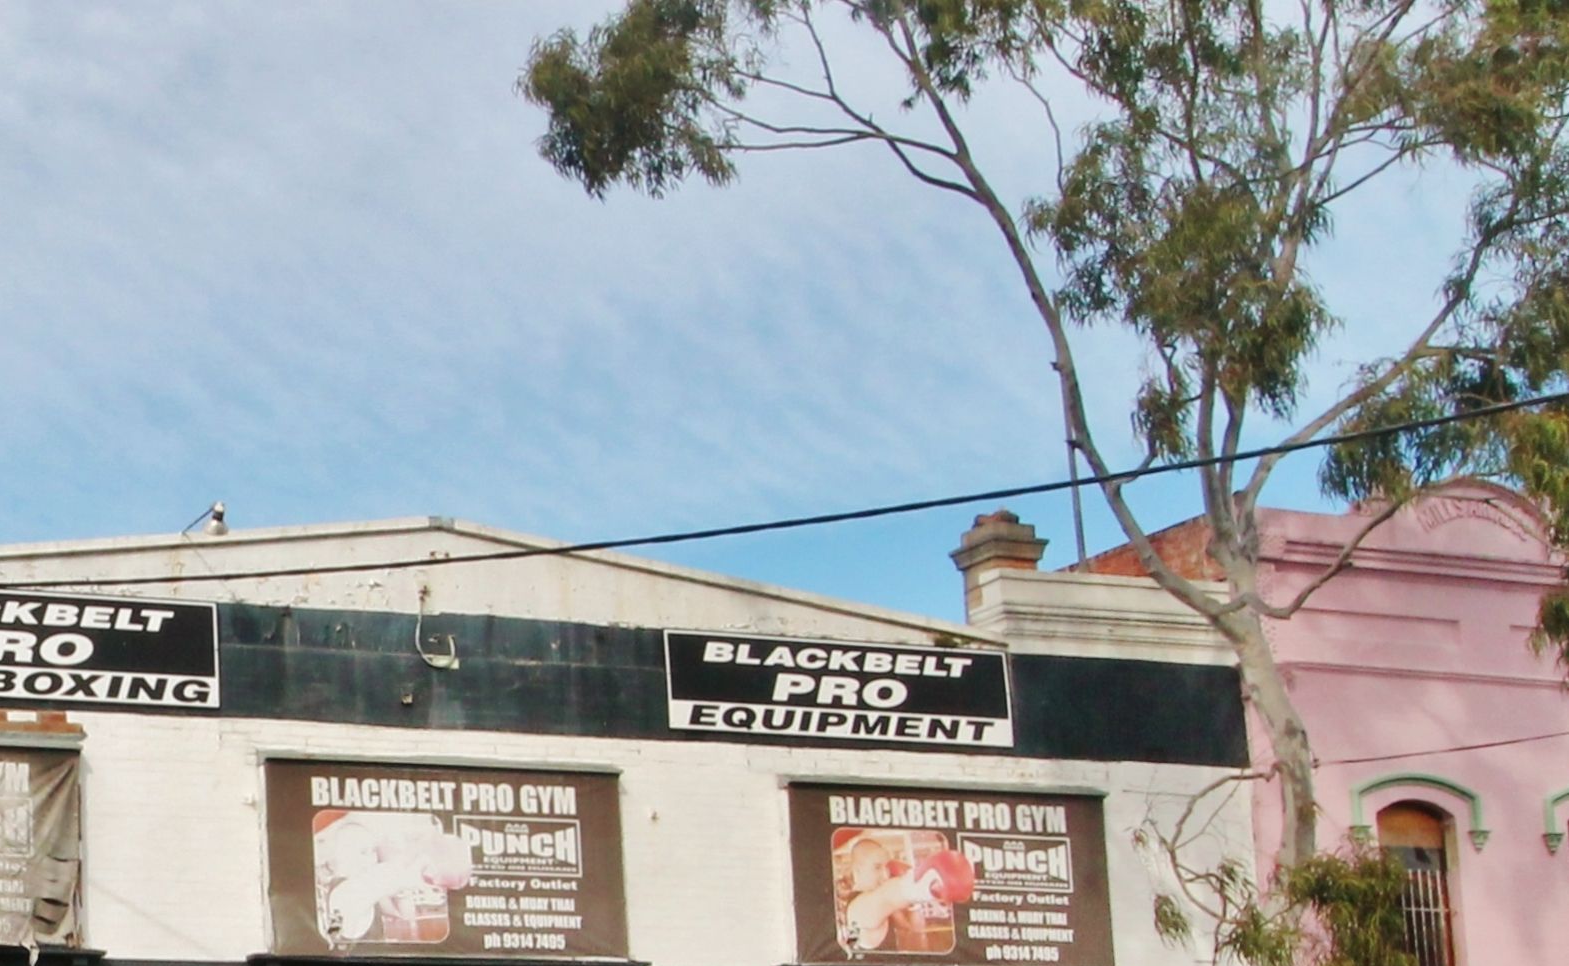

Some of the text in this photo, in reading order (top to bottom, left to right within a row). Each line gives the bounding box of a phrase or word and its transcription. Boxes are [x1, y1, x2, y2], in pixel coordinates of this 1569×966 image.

[703, 641, 972, 678] BLACKBELT
[772, 672, 909, 709] PRO
[689, 704, 995, 741] EQUIPMENT
[311, 776, 576, 815] BLACKBELT PRO GYM
[829, 796, 1067, 833] BLACKBELT PRO GYM
[460, 823, 577, 865] PUNCH
[964, 840, 1068, 881] PUNCH
[469, 876, 578, 892] Factory Outlet
[466, 895, 506, 910] BOXING
[550, 897, 575, 912] THAI
[972, 891, 1070, 906] Factory Outlet
[464, 912, 510, 927] CLASSES
[524, 914, 582, 929] EQUIPMENT
[968, 925, 1010, 940] CLASSES
[1021, 927, 1074, 943] EQUIPMENT
[484, 932, 501, 949] ph
[503, 932, 533, 949] 9314
[985, 945, 1002, 961] ph
[1002, 945, 1030, 961] 9314
